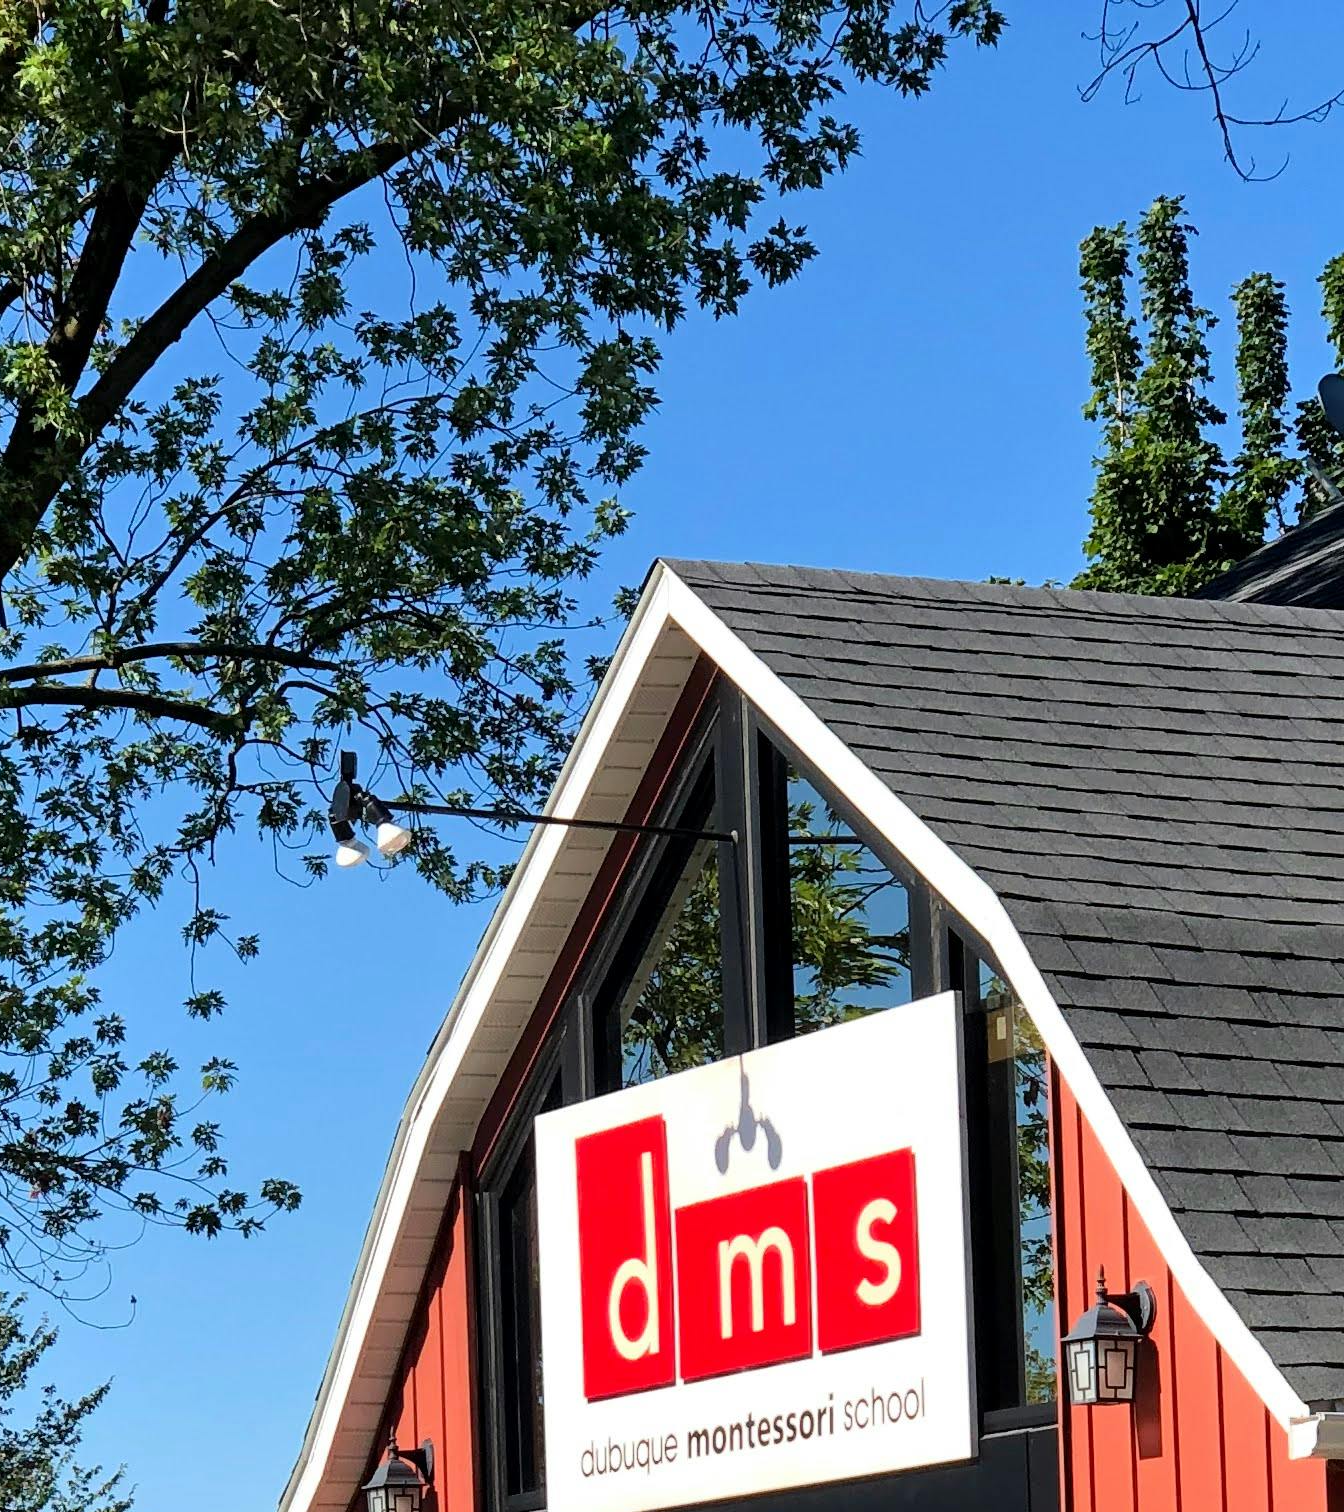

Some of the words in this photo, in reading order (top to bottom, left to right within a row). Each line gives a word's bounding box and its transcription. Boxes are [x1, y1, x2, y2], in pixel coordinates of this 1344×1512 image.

[608, 1151, 903, 1361] dms
[580, 1433, 679, 1478] dubuque
[686, 1393, 835, 1460] montessori
[843, 1377, 926, 1431] school
